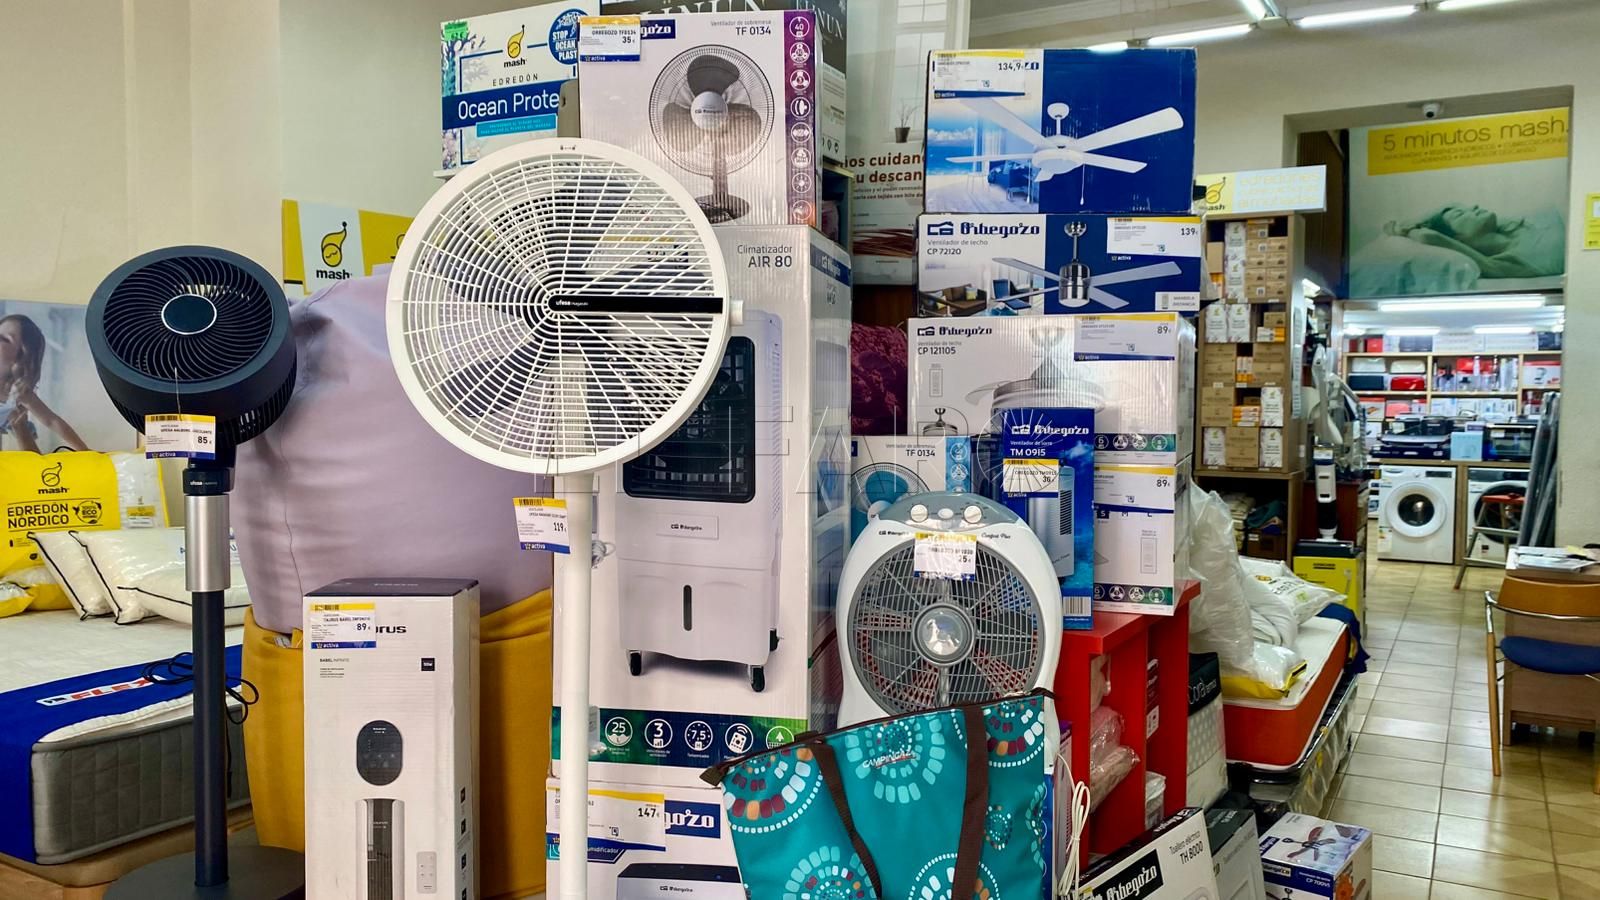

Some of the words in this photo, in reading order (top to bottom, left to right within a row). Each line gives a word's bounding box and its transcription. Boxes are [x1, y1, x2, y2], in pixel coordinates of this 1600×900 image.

[552, 30, 568, 41] STOP
[736, 27, 747, 35] TF
[749, 26, 771, 35] 0134
[555, 40, 576, 50] OCEAN
[622, 36, 631, 44] 35
[504, 58, 526, 68] mash
[458, 99, 508, 120] Ocean
[513, 89, 560, 112] Prote
[1383, 134, 1396, 152] 5
[1404, 127, 1491, 149] minutos
[869, 152, 925, 168] cuidan
[869, 171, 922, 183] descan
[960, 221, 1040, 238] Orbegozo
[737, 244, 792, 255] Climatizador
[748, 256, 770, 268] AIR
[774, 255, 792, 268] 80
[316, 269, 350, 280] mash
[939, 326, 992, 337] Orbegozo
[918, 347, 929, 355] CP
[930, 347, 956, 355] 121105
[198, 436, 207, 444] 85
[1010, 448, 1023, 456] TM
[1025, 448, 1046, 456] 0915
[38, 486, 67, 494] mash
[8, 502, 69, 517] EDREDÓN
[553, 522, 564, 532] 119
[612, 722, 626, 733] 25
[653, 722, 663, 738] 3
[1180, 852, 1190, 864] TH
